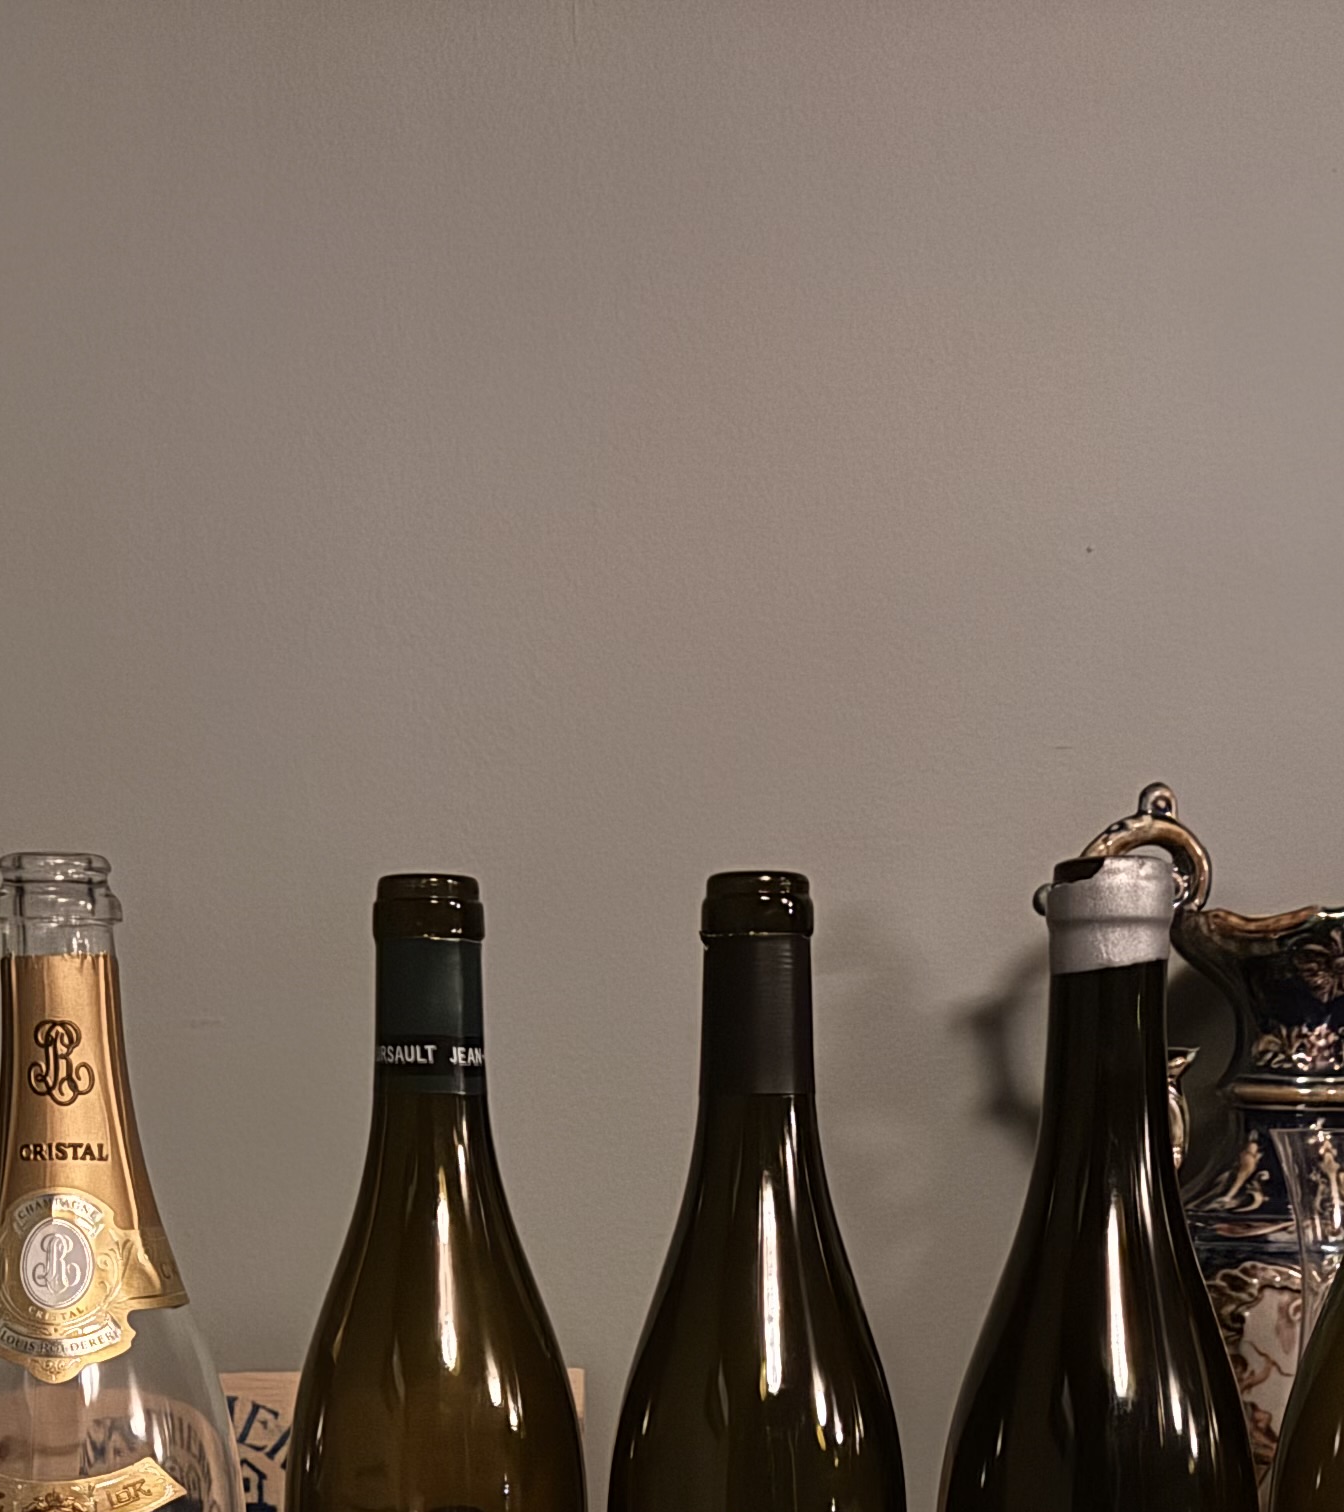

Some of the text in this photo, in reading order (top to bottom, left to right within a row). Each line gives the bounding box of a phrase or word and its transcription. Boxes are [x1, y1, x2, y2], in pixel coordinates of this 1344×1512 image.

[19, 1143, 109, 1161] CRISTAL
[18, 1197, 99, 1220] CHAMPAGNE
[28, 1304, 85, 1321] CRISTAL
[0, 1329, 39, 1353] LOUIS
